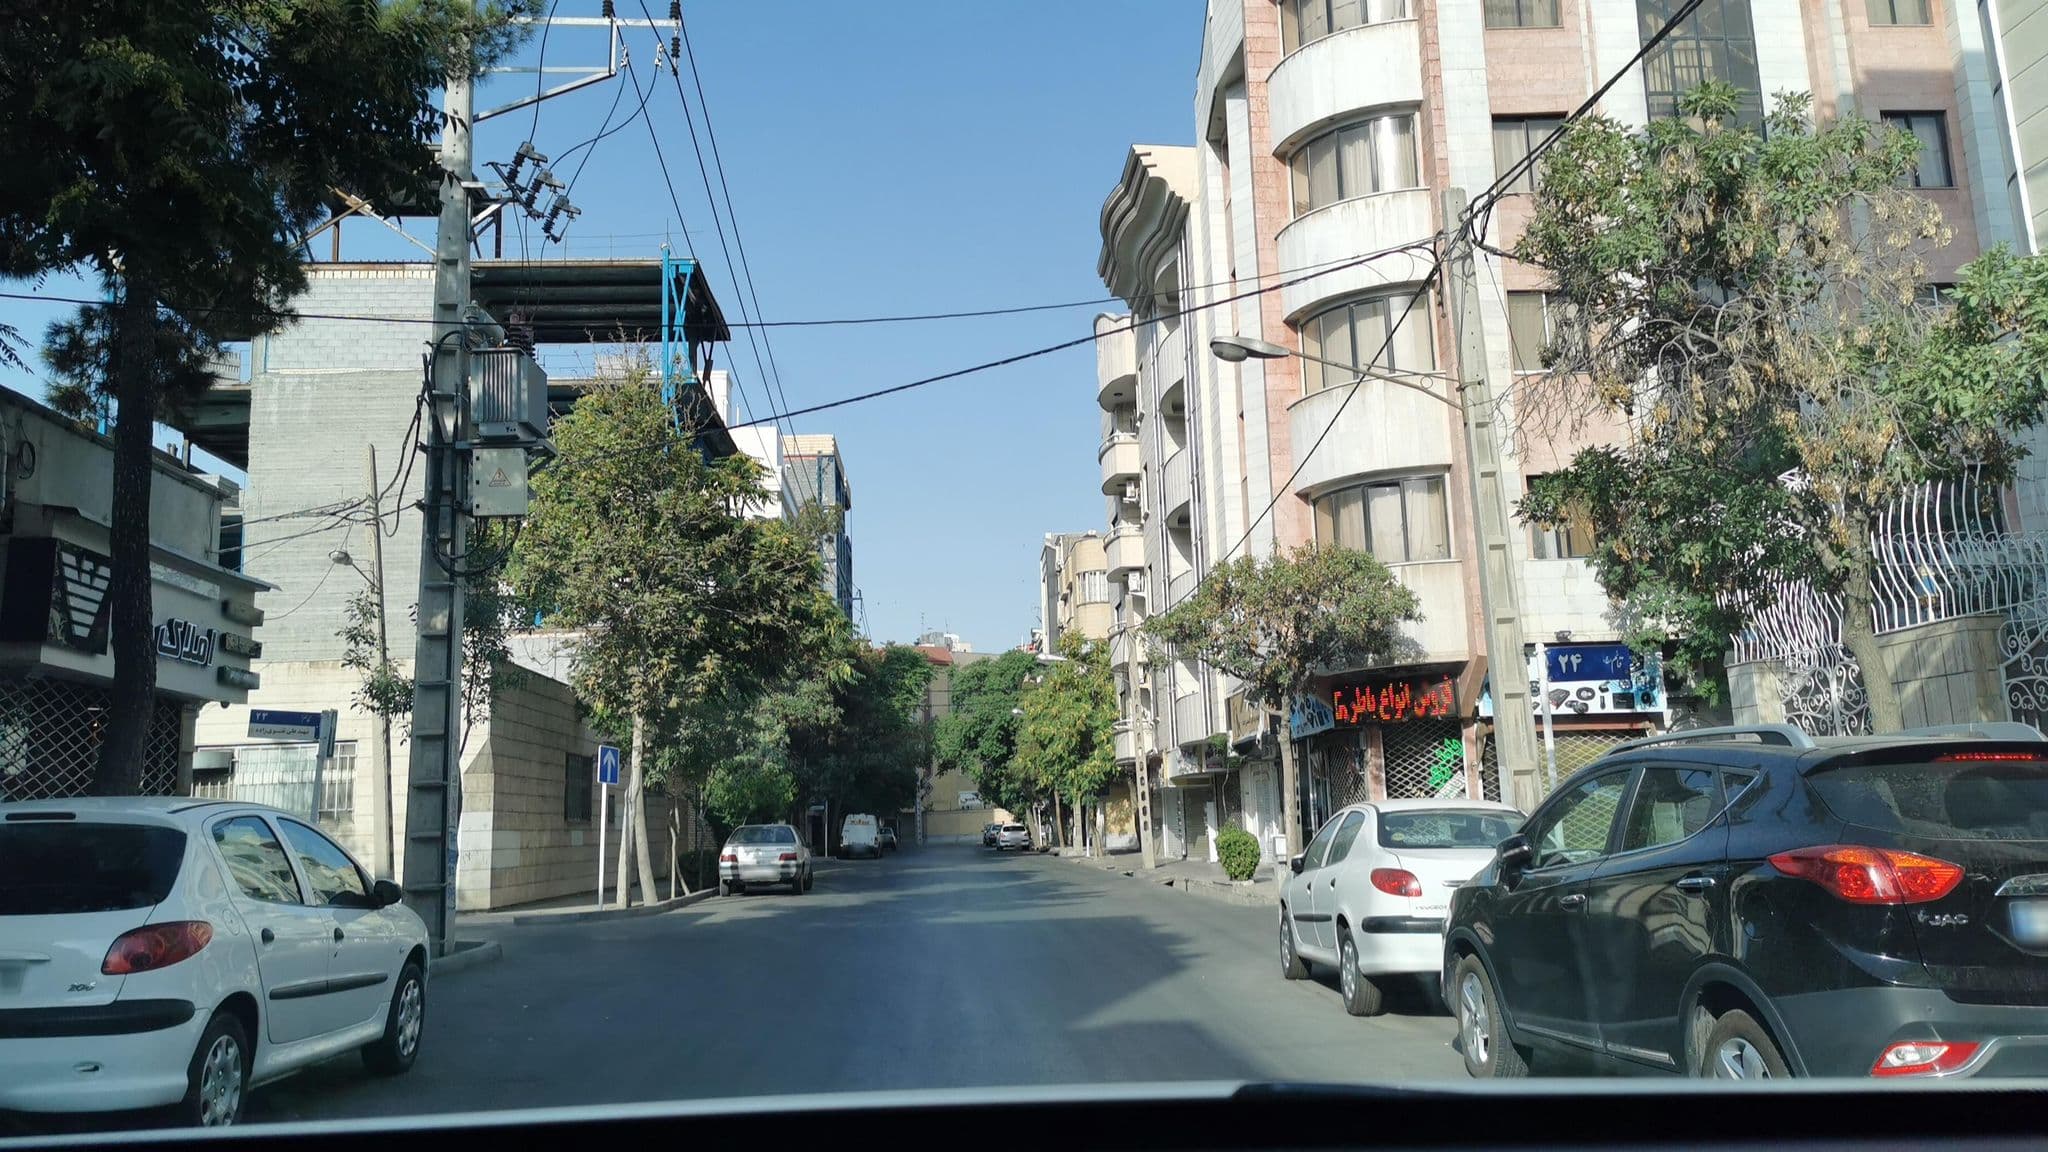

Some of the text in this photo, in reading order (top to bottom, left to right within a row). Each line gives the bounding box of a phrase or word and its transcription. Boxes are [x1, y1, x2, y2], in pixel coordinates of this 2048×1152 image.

[154, 617, 219, 668] املاک
[1558, 653, 1583, 674] ۲۴
[1379, 681, 1411, 720] انواع
[1413, 674, 1454, 718] فروش
[1928, 913, 1969, 927] JAC
